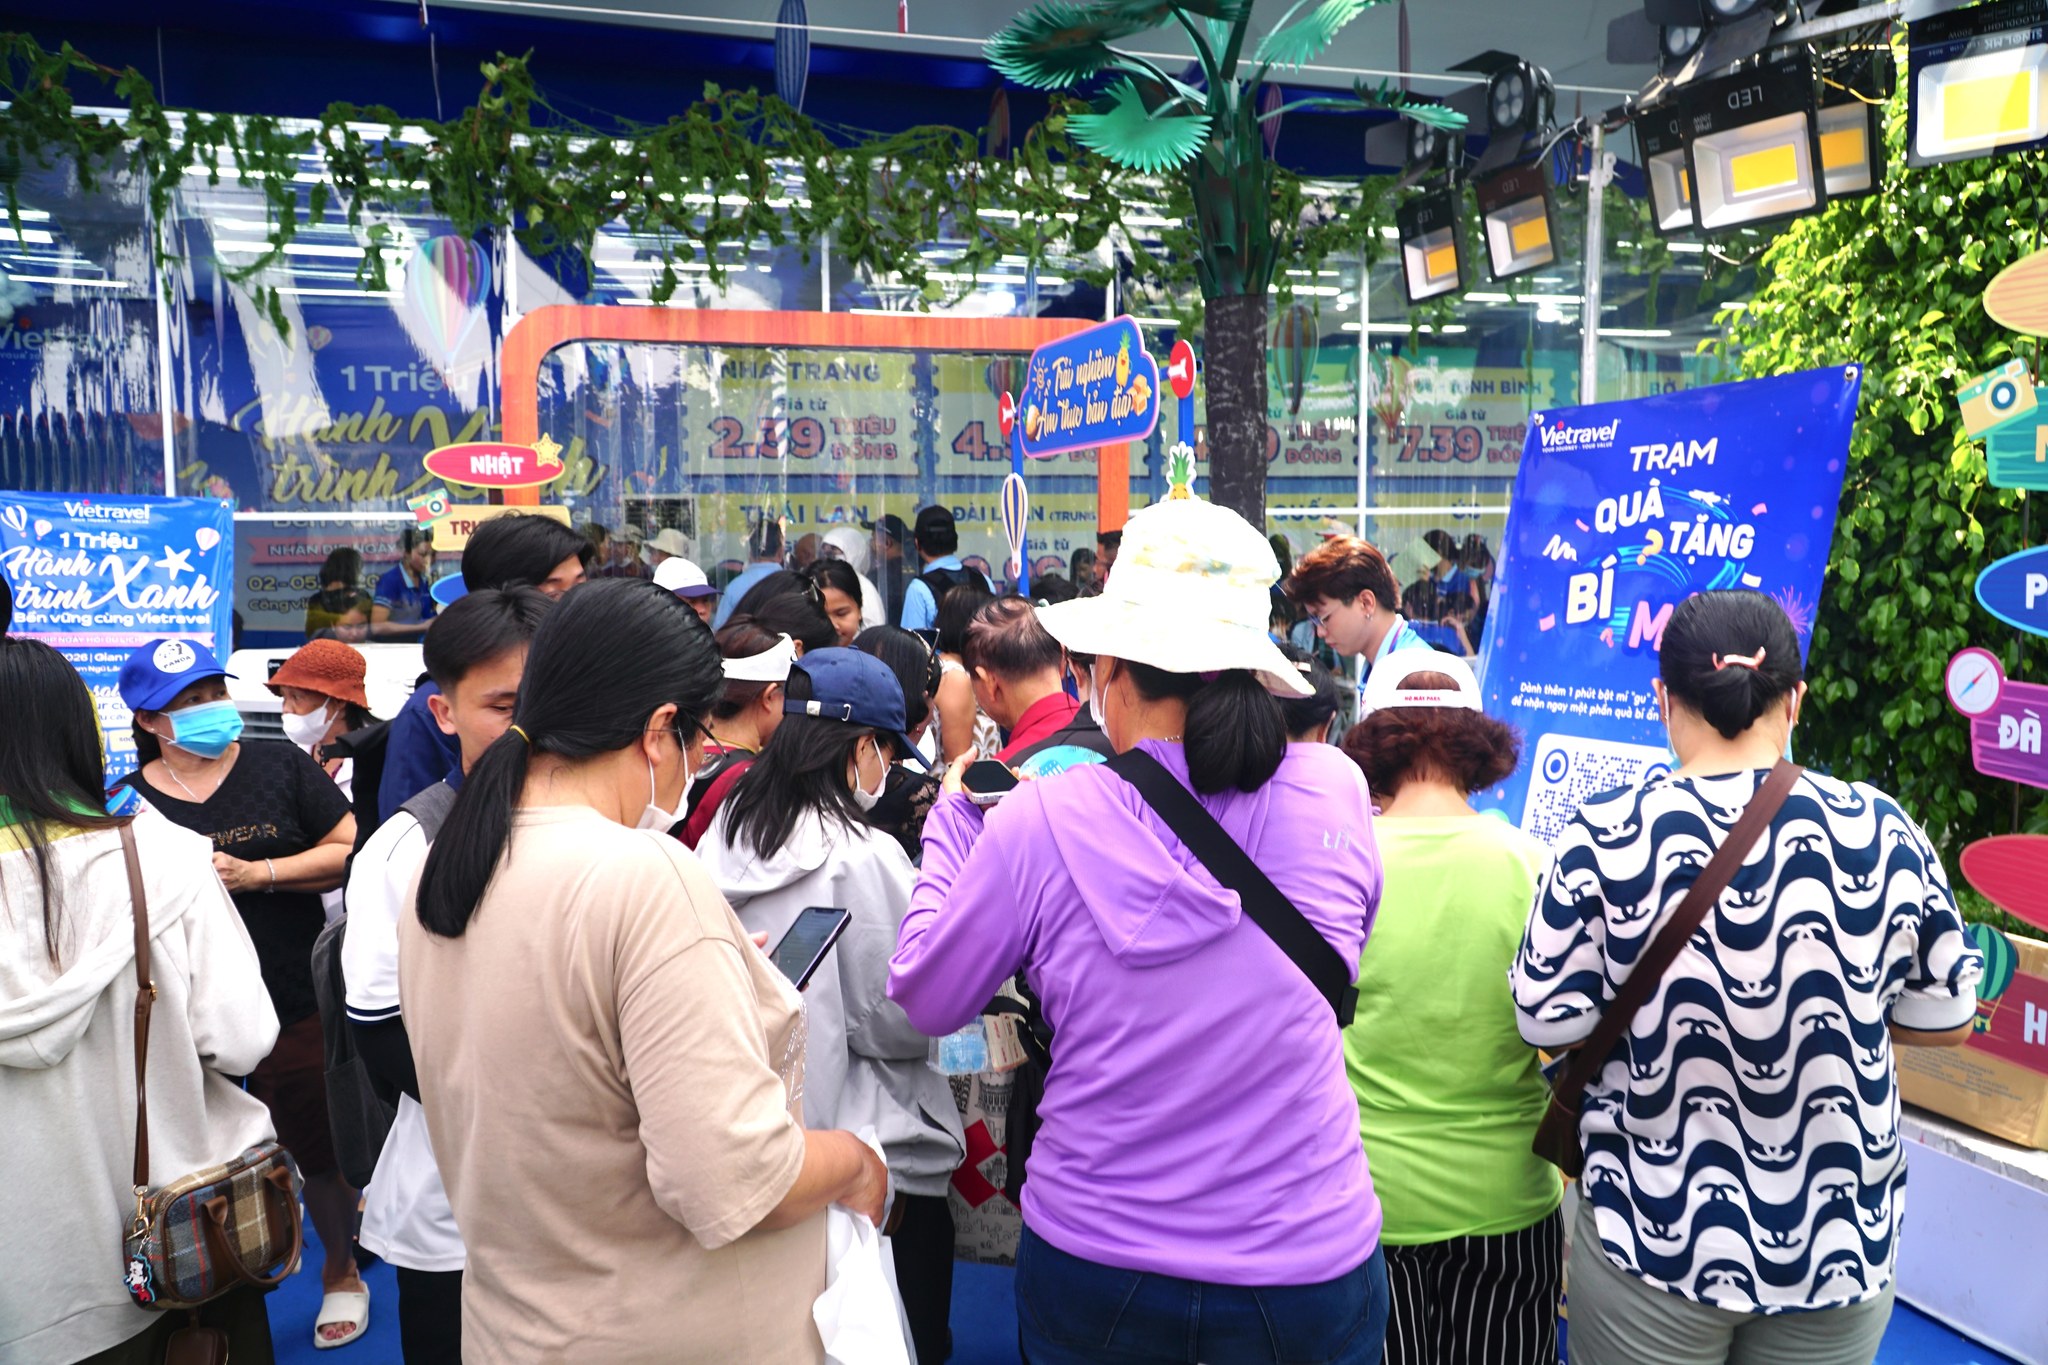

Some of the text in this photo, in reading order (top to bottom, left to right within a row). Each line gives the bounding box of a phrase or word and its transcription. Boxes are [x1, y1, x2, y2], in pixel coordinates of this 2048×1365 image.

[1727, 85, 1763, 110] LED
[1502, 177, 1519, 194] LED
[1417, 208, 1433, 224] LED
[340, 365, 357, 392] 1
[721, 361, 881, 382] NHA TRANG
[1053, 348, 1116, 397] Trải nghiệm
[1500, 377, 1542, 395] BÌNH
[1058, 399, 1083, 436] thực
[1086, 391, 1108, 426] bản
[1111, 388, 1134, 427] địa
[1445, 409, 1486, 421] Giá từ
[707, 414, 897, 460] 2.39 TRIỆU
[1397, 423, 1526, 463] 7.39 TRIỆ
[1540, 418, 1618, 447] Vietravel
[831, 438, 898, 461] ĐỒNG
[1285, 443, 1342, 464] ĐỒNG
[1630, 437, 1718, 475] TRẠM
[470, 452, 524, 479] NHẬT
[64, 499, 150, 519] Vietravel
[815, 504, 868, 524] LAN
[953, 500, 986, 522] ĐÀI
[59, 531, 138, 553] 1 Triệu
[1054, 539, 1069, 551] từ
[1669, 514, 1755, 565] TẶNG
[0, 545, 220, 610] Hành Xanh
[15, 579, 102, 610] trình
[1566, 554, 1618, 625] BÍ
[50, 611, 92, 626] vững
[94, 612, 134, 627] cùng
[136, 613, 210, 625] Vietravel
[94, 652, 123, 662] Gian
[163, 655, 191, 669] PANDA
[1520, 682, 1542, 693] Dành
[1544, 684, 1566, 696] thêm
[1569, 686, 1573, 697] 1
[1574, 687, 1596, 700] phút
[1598, 688, 1614, 702] bật
[1616, 690, 1629, 702] mí
[1524, 697, 1545, 711] nhận
[1546, 700, 1568, 714] ngay
[1570, 701, 1588, 716] một
[1589, 702, 1613, 716] phần
[1614, 706, 1632, 720] quà
[1634, 707, 1645, 720] bí
[1998, 708, 2042, 755] ĐÀ
